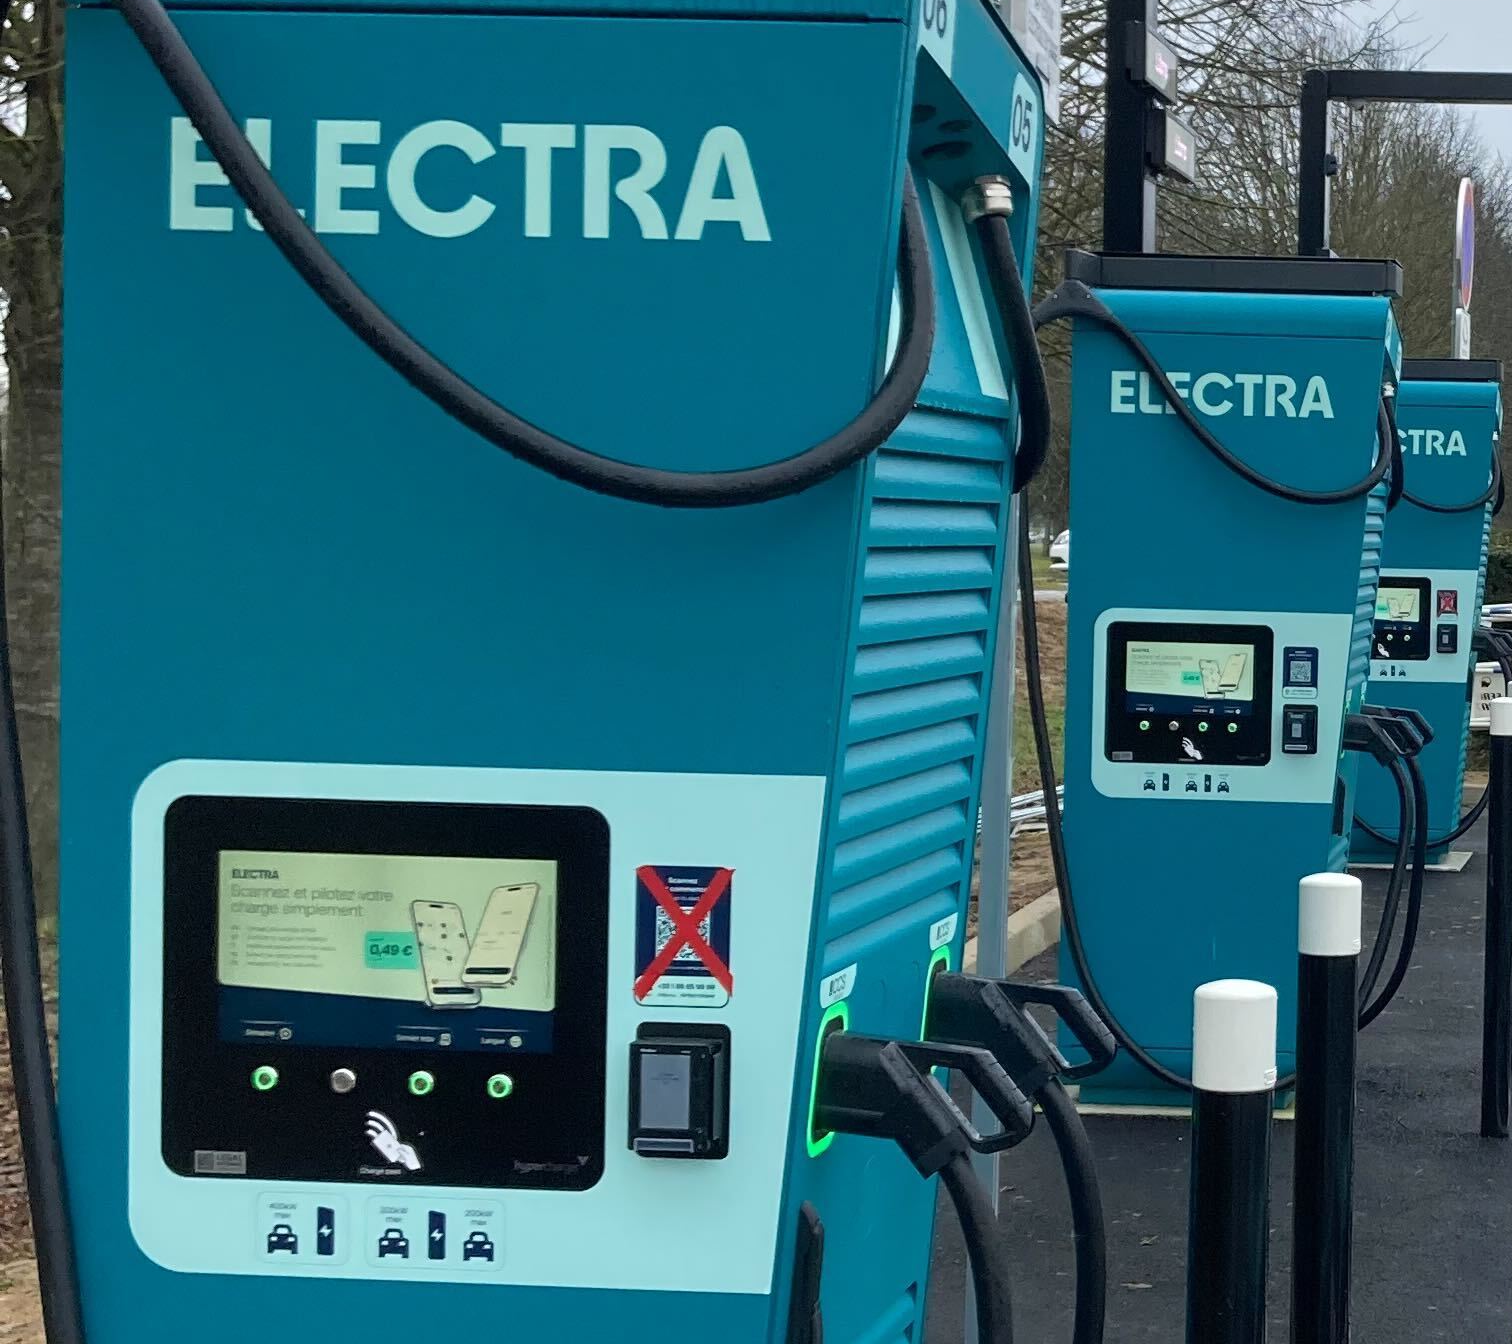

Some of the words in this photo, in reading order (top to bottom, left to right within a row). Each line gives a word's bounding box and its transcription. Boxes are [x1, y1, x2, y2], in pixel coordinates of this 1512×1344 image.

[1012, 94, 1033, 152] 05
[231, 869, 280, 880] ELECTRA
[230, 884, 290, 899] Scannez
[293, 887, 307, 900] et
[311, 887, 355, 902] pilotez
[359, 889, 394, 901] votre
[230, 900, 278, 917] charge
[283, 903, 364, 918] simplement
